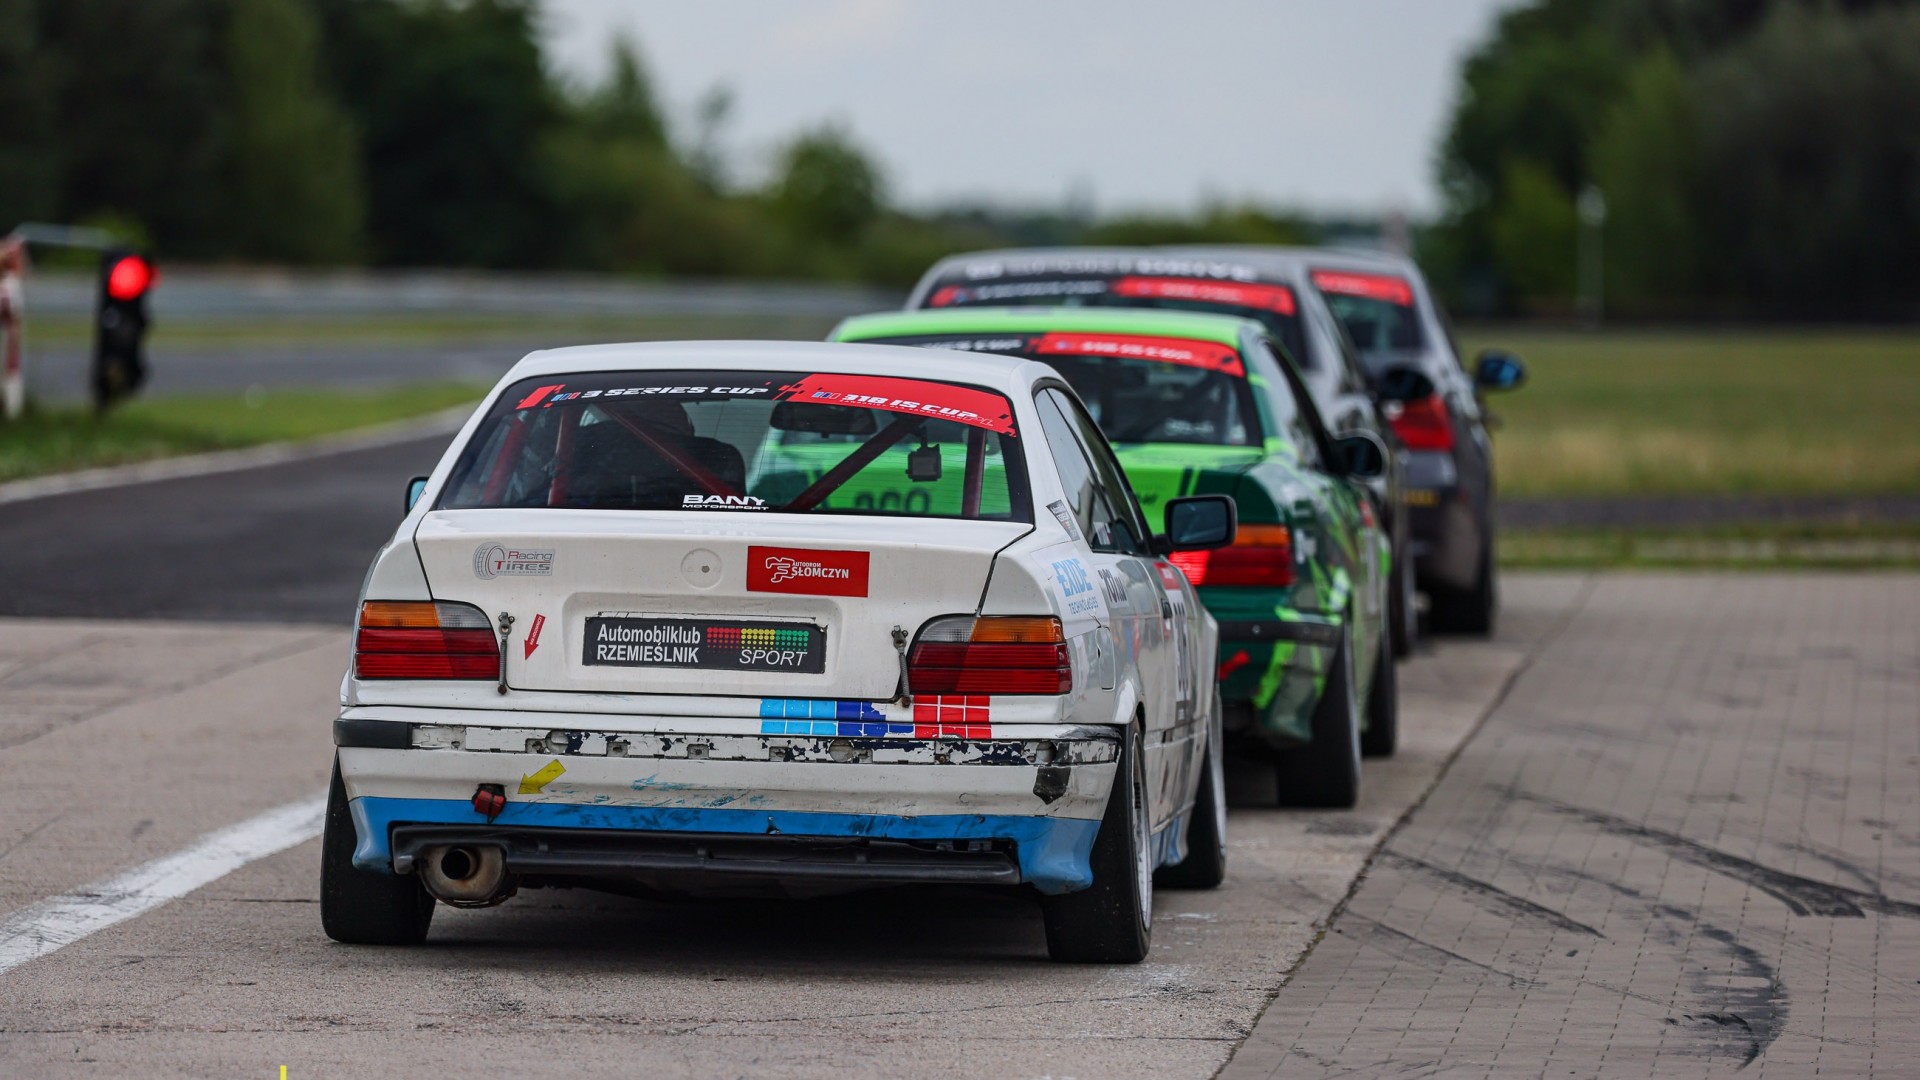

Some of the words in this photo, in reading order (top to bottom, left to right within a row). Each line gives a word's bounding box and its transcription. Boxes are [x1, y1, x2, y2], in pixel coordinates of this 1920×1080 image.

[581, 390, 601, 399] 3
[604, 386, 709, 397] SERIES
[710, 386, 769, 395] CUP
[842, 393, 889, 405] 318
[890, 399, 920, 409] IS
[921, 404, 979, 418] CUP
[683, 494, 766, 506] BANY
[508, 550, 553, 561] Racing
[791, 566, 849, 579] SŁOMCZYN
[1051, 558, 1093, 597] EXIDE
[597, 623, 701, 644] Automobilklub
[597, 642, 700, 663] RZEMIEŚLNIK
[739, 648, 808, 667] SPORT
